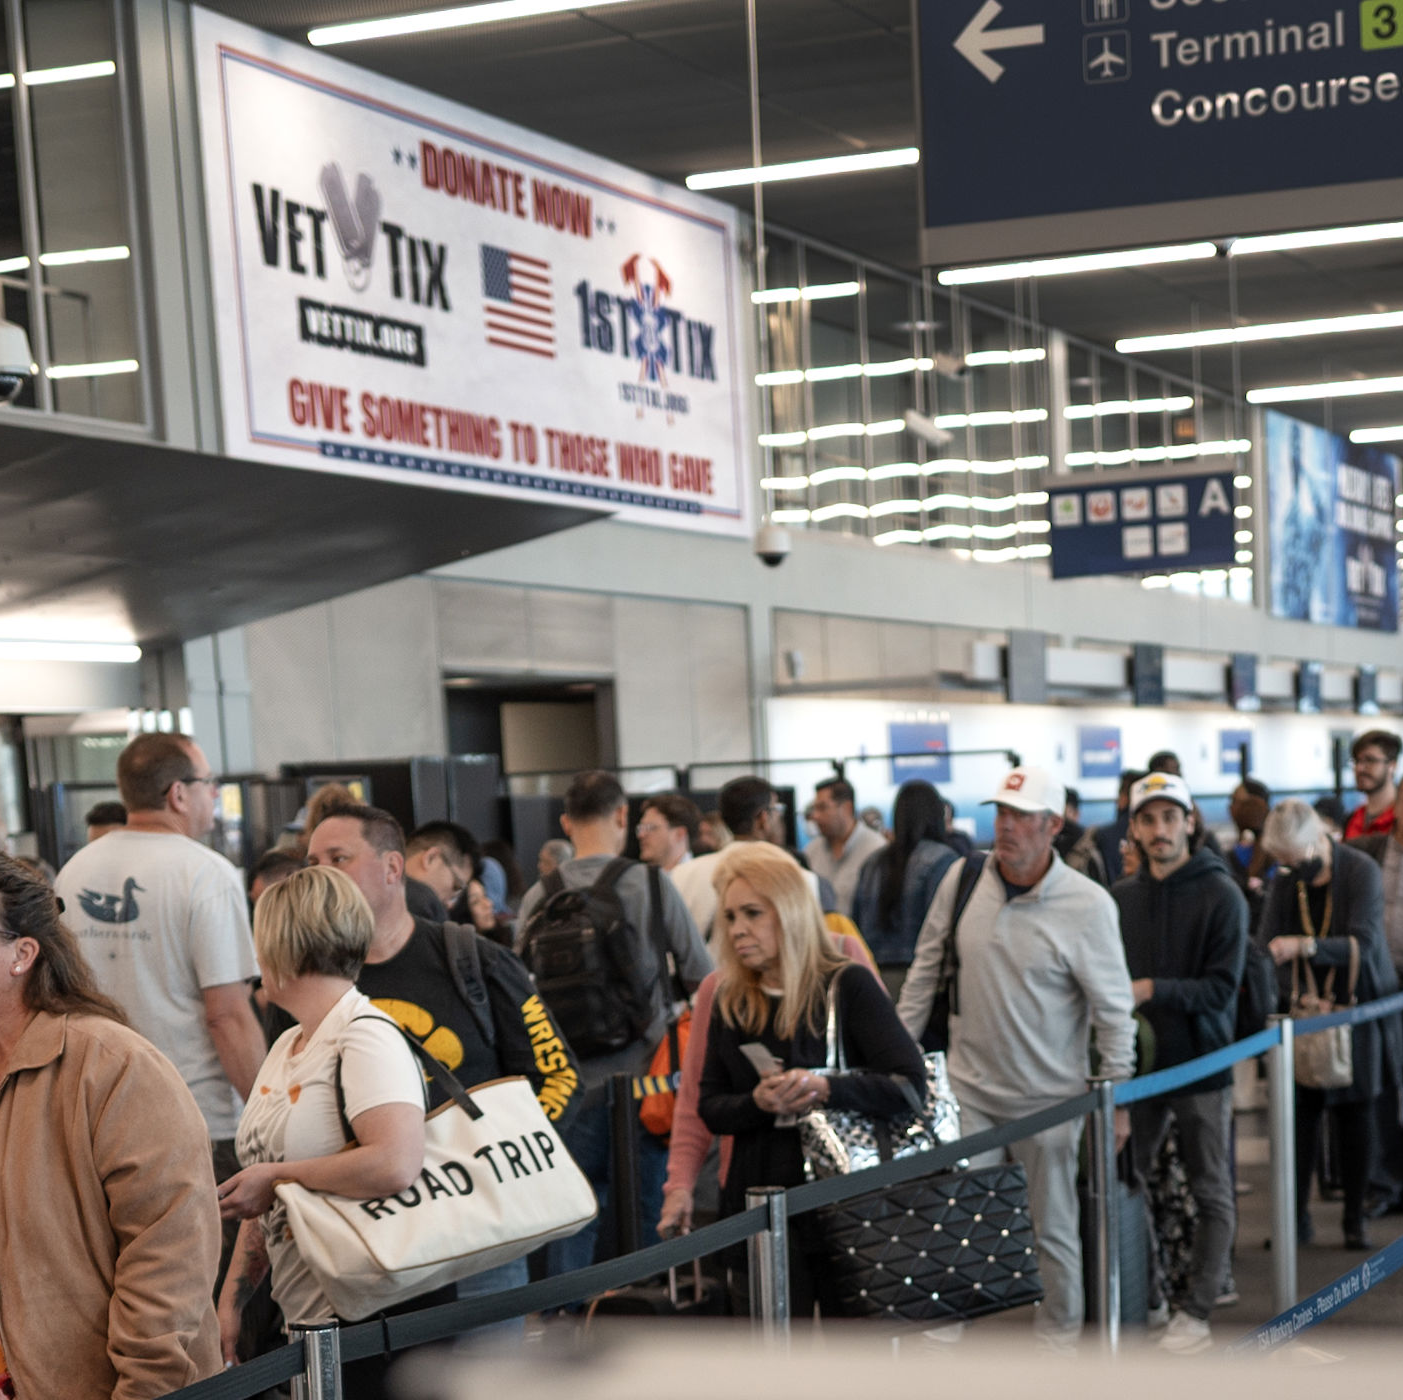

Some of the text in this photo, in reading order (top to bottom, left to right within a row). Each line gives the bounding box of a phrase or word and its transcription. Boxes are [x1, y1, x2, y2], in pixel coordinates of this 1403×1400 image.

[1151, 4, 1398, 68] Terminal 3
[419, 139, 593, 240] DONATE NOW
[252, 183, 453, 312] VET TIX
[572, 279, 718, 383] 1ST TIX
[287, 377, 716, 497] GIVE SOMETHING TO THOSE WHO GAVE
[1198, 478, 1230, 518] A
[521, 994, 577, 1121] WRESTING
[473, 1131, 556, 1184] TRIP
